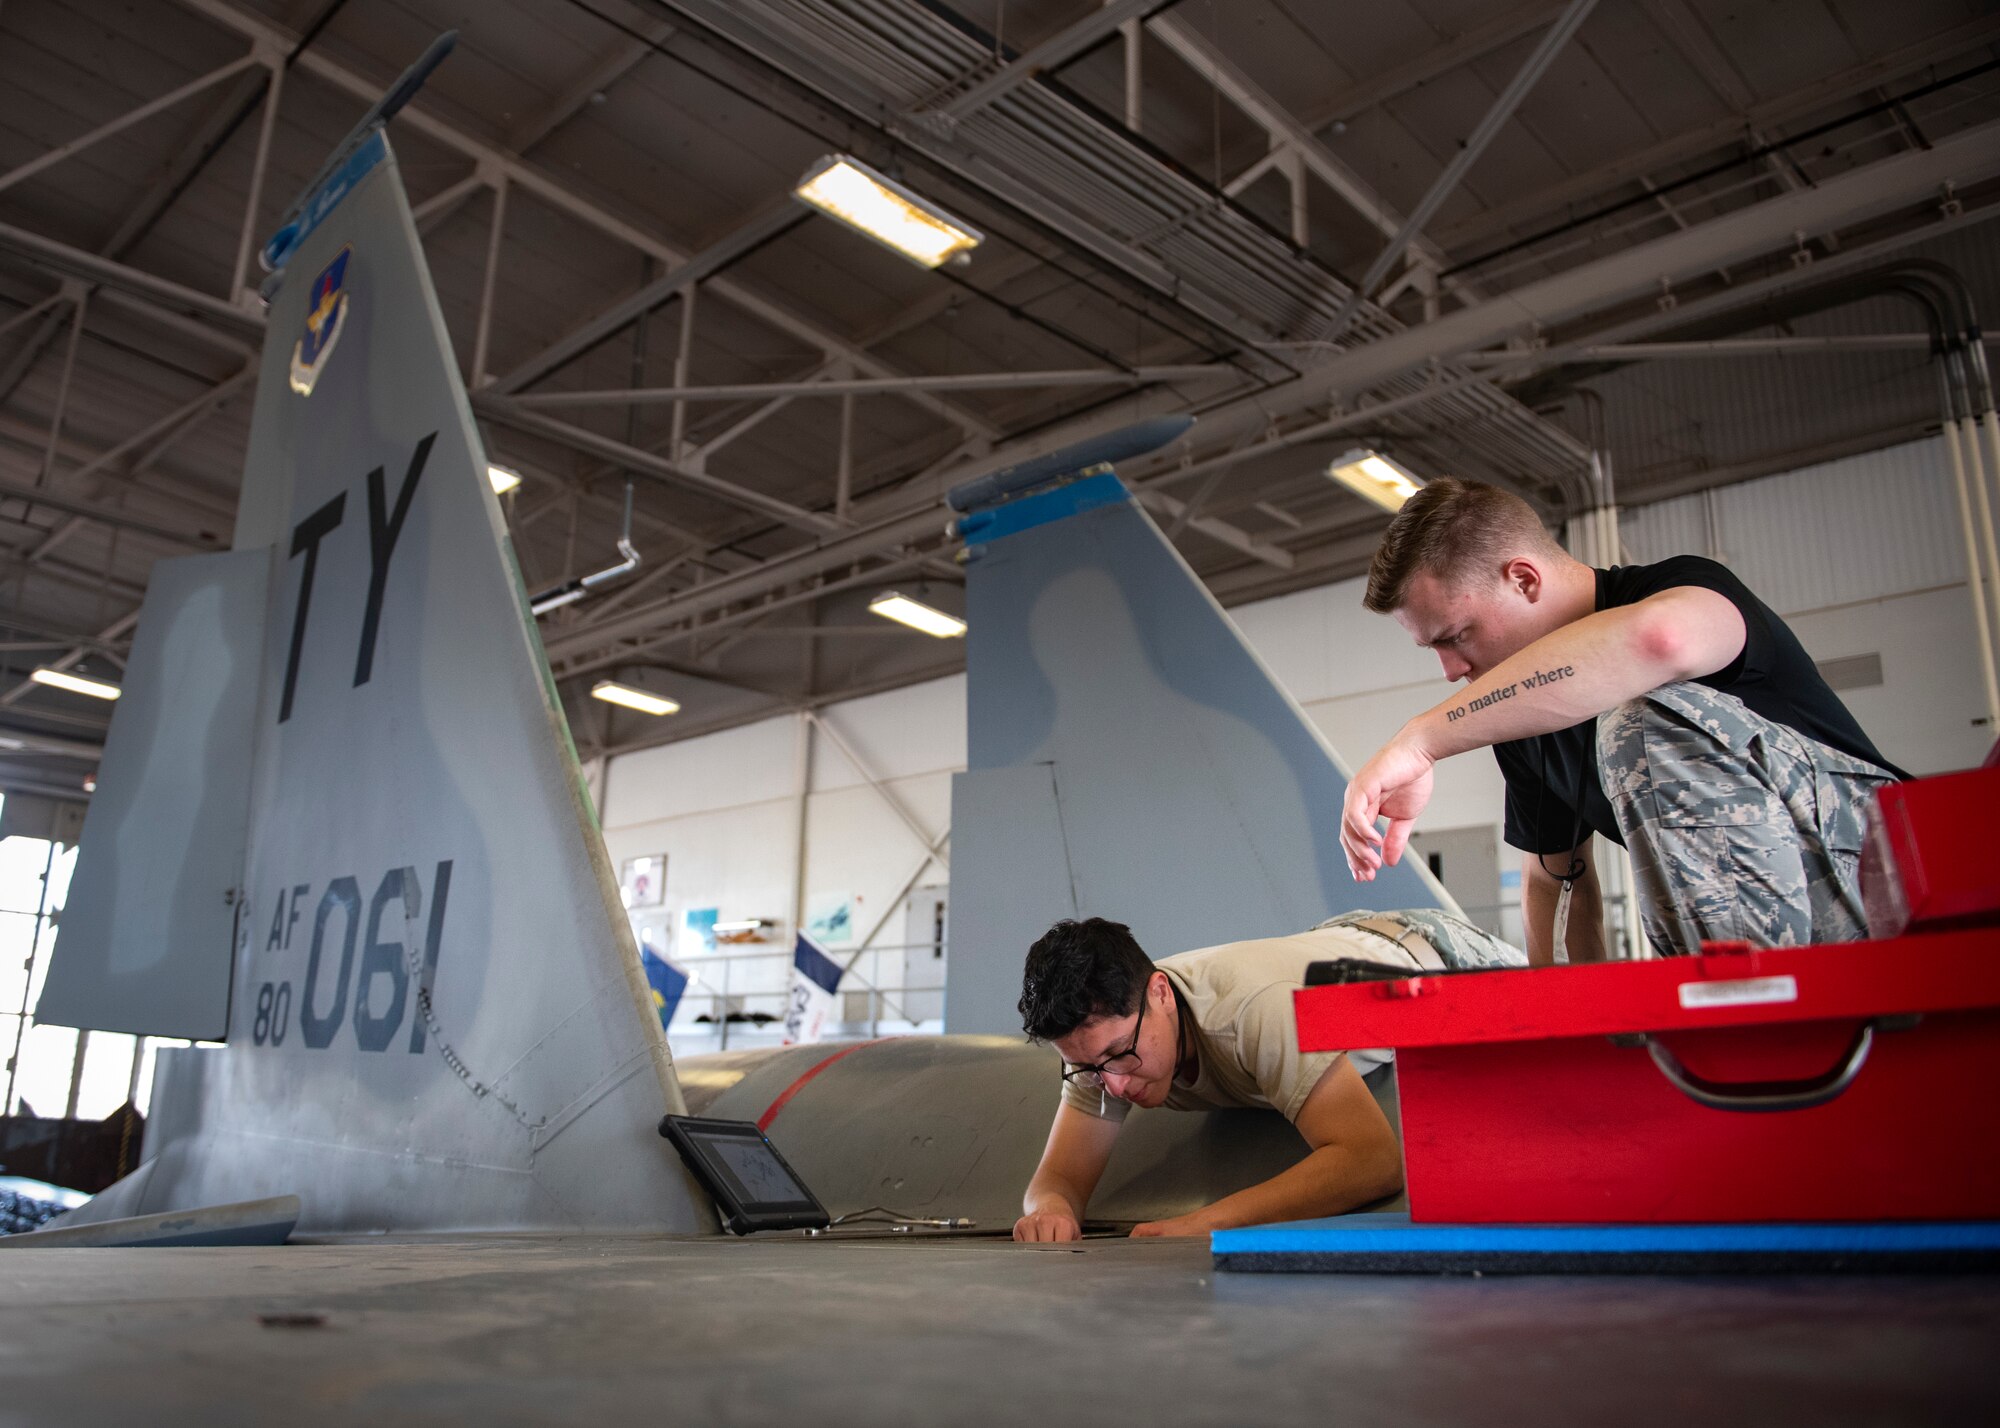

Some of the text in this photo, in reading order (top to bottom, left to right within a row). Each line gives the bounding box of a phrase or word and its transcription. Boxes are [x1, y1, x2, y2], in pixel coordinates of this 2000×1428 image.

[278, 430, 438, 724] TY
[1446, 665, 1575, 721] no matter where
[266, 884, 311, 952] AF
[300, 859, 453, 1055] 061
[253, 981, 292, 1047] 80
